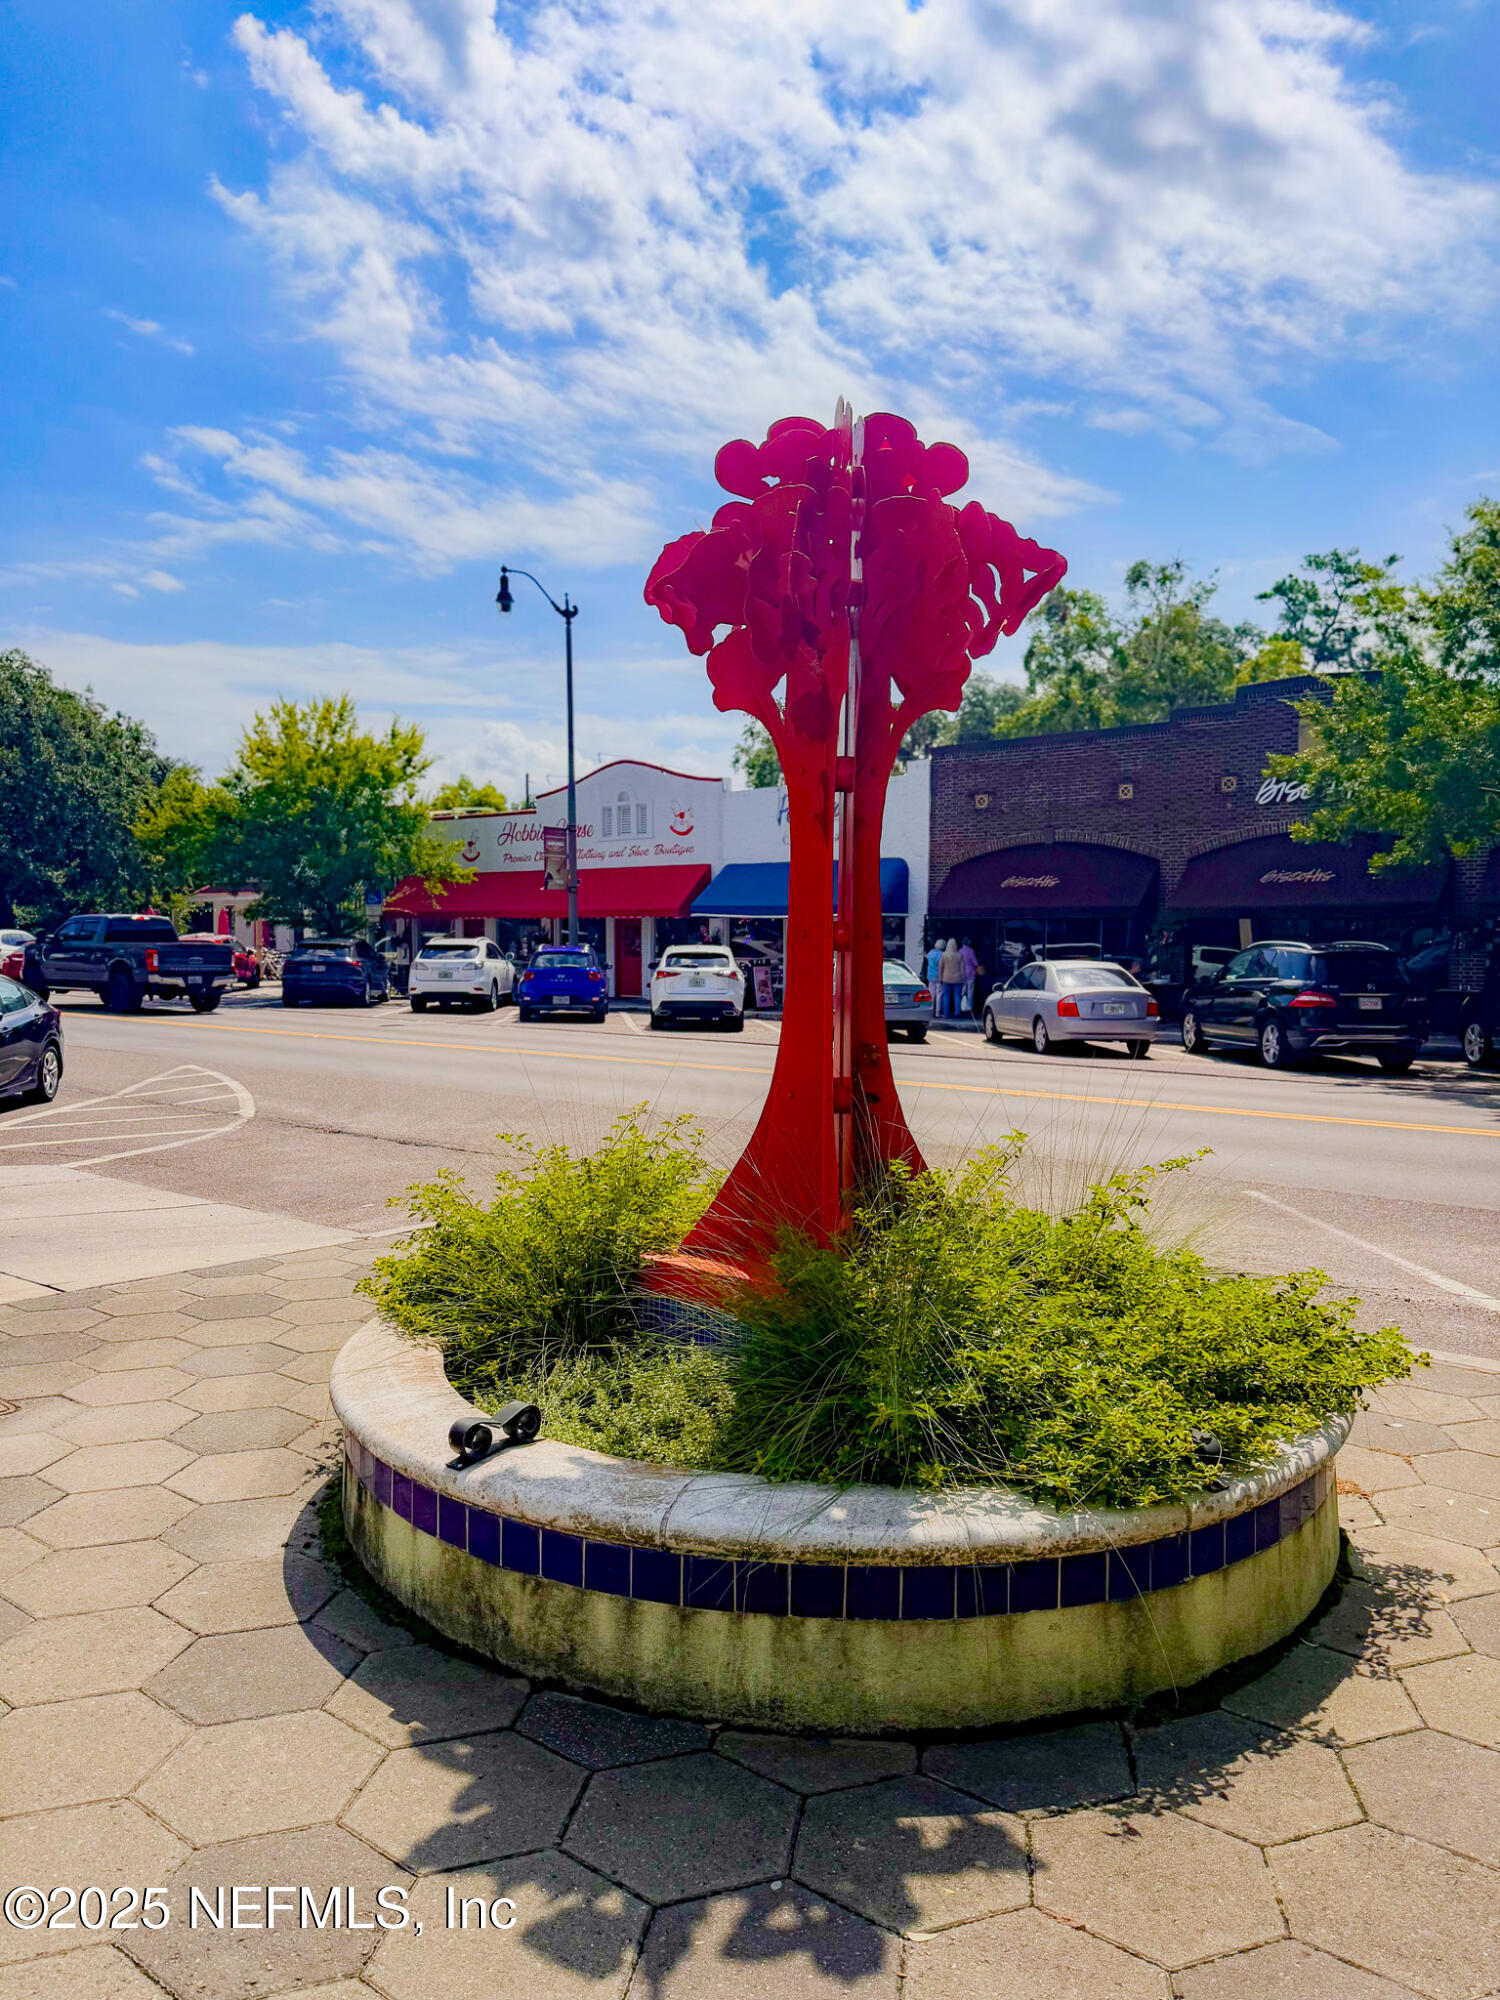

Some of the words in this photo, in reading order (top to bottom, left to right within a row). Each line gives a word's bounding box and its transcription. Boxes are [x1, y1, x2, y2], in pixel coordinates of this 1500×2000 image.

[608, 846, 627, 858] and
[628, 845, 650, 858] Shoe
[653, 843, 695, 857] Boutique
